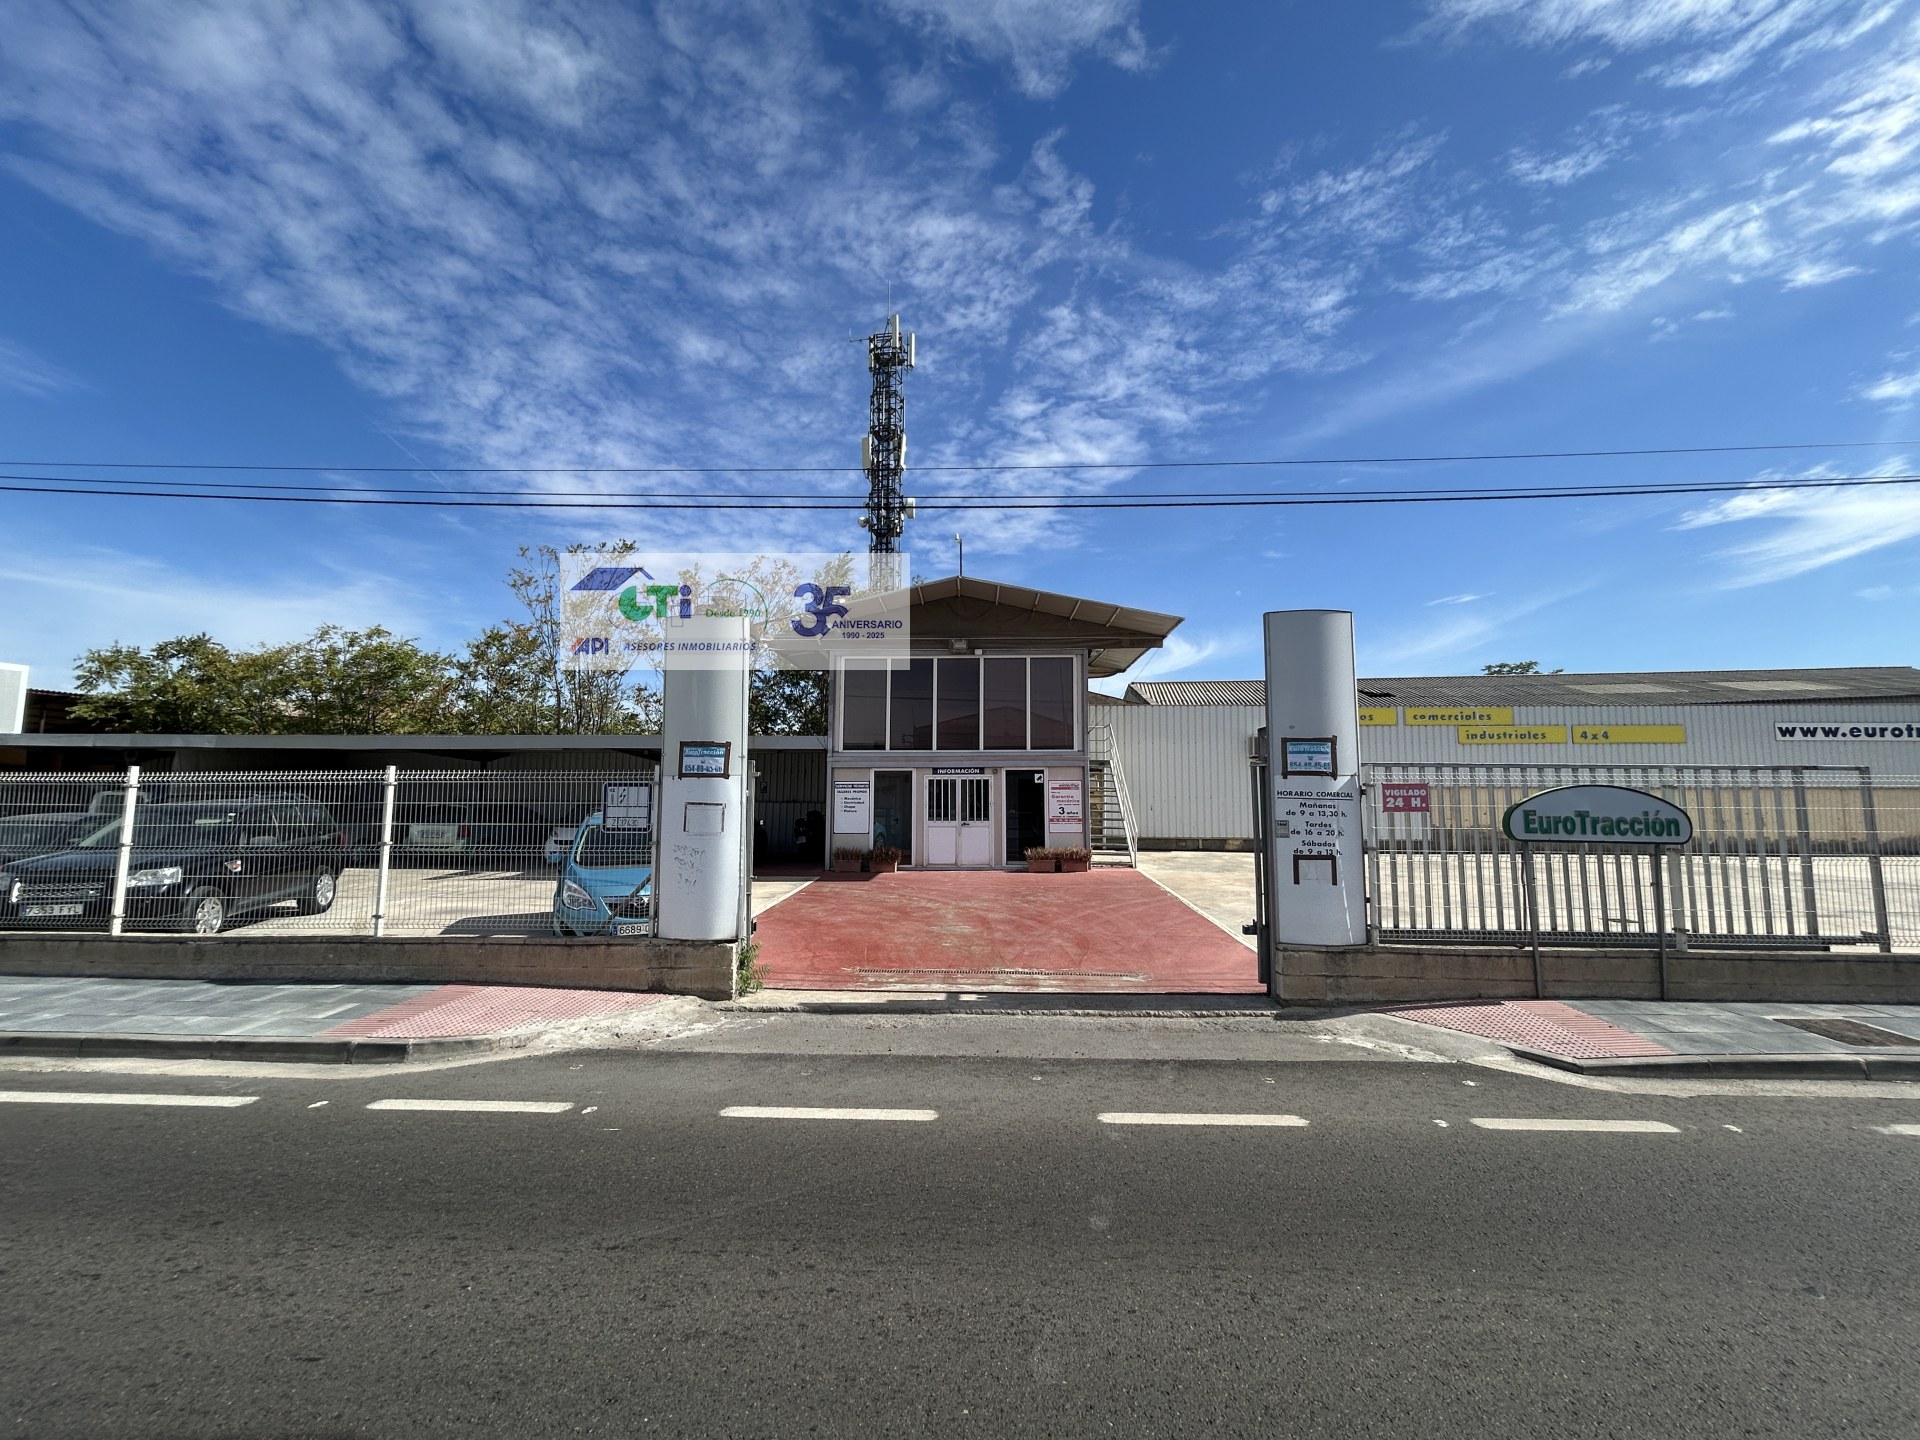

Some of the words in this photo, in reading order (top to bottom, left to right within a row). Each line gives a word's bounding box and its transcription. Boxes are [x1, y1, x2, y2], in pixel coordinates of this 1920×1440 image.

[1412, 711, 1492, 722] comerciales
[1465, 729, 1547, 741] industriales
[1315, 791, 1354, 799] COMERCIAL
[1384, 788, 1427, 797] VIGILADO
[1299, 801, 1336, 809] Mañanas
[1385, 797, 1404, 808] 24
[1410, 797, 1426, 808] H.
[1058, 806, 1065, 815] 3
[1318, 810, 1339, 818] 13,30
[1522, 808, 1681, 838] EuroTracción
[1325, 829, 1336, 837] 20
[1301, 839, 1336, 847] Sábados
[619, 925, 642, 935] 6689
